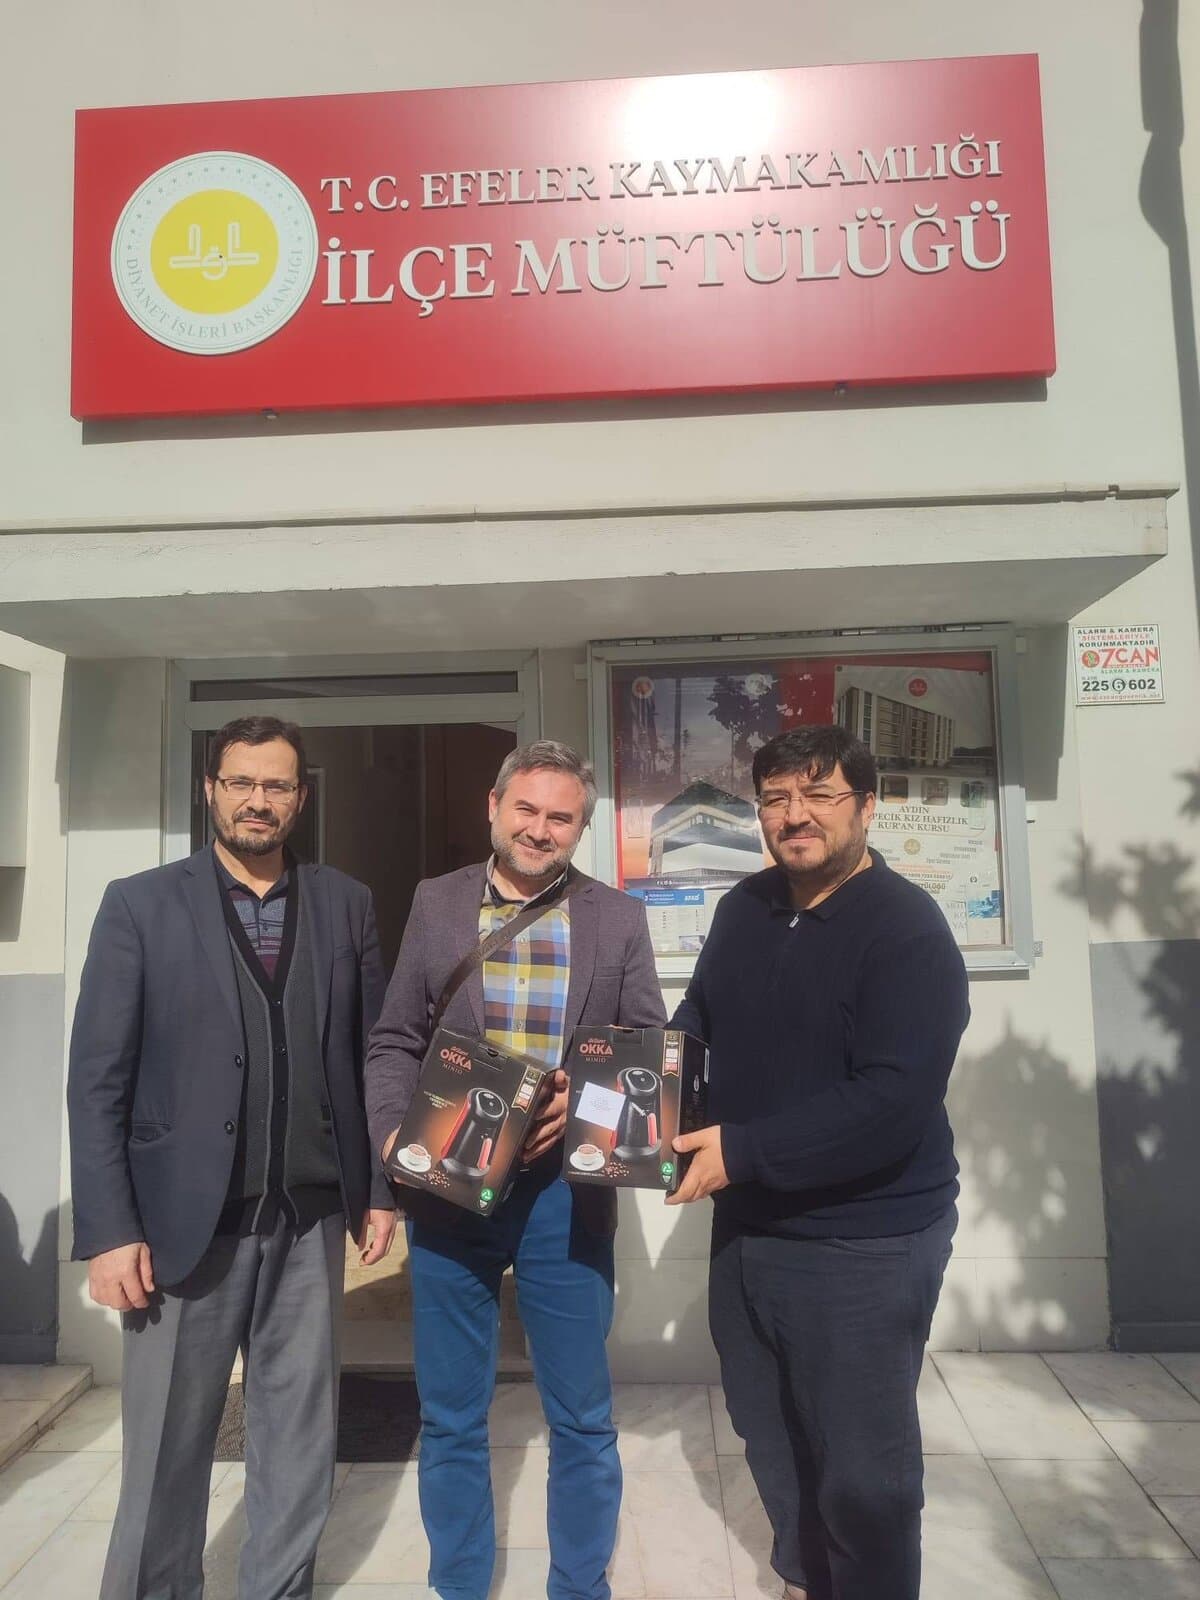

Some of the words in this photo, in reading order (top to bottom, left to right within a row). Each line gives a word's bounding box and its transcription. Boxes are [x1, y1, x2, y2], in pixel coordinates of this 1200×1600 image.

[321, 174, 409, 213] T.C.
[421, 166, 600, 209] EFELER
[609, 133, 1003, 198] KAYMAKAMLIĞI
[321, 236, 496, 318] İLÇE
[511, 199, 1011, 296] MÜFTÜLÜĞÜ
[126, 258, 171, 324] DİYANET
[170, 314, 228, 339] İŞLERİ
[233, 248, 304, 335] BAŞKANLIĞI
[1082, 680, 1110, 692] 225
[1128, 679, 1156, 690] 602
[899, 805, 929, 814] AYDIN
[904, 814, 920, 822] KIZ
[923, 815, 968, 825] HAFIZLIK
[878, 821, 915, 830] KUR'AN
[917, 823, 950, 832] KURSU
[579, 1043, 613, 1056] OKKA
[440, 1048, 472, 1071] OKKA
